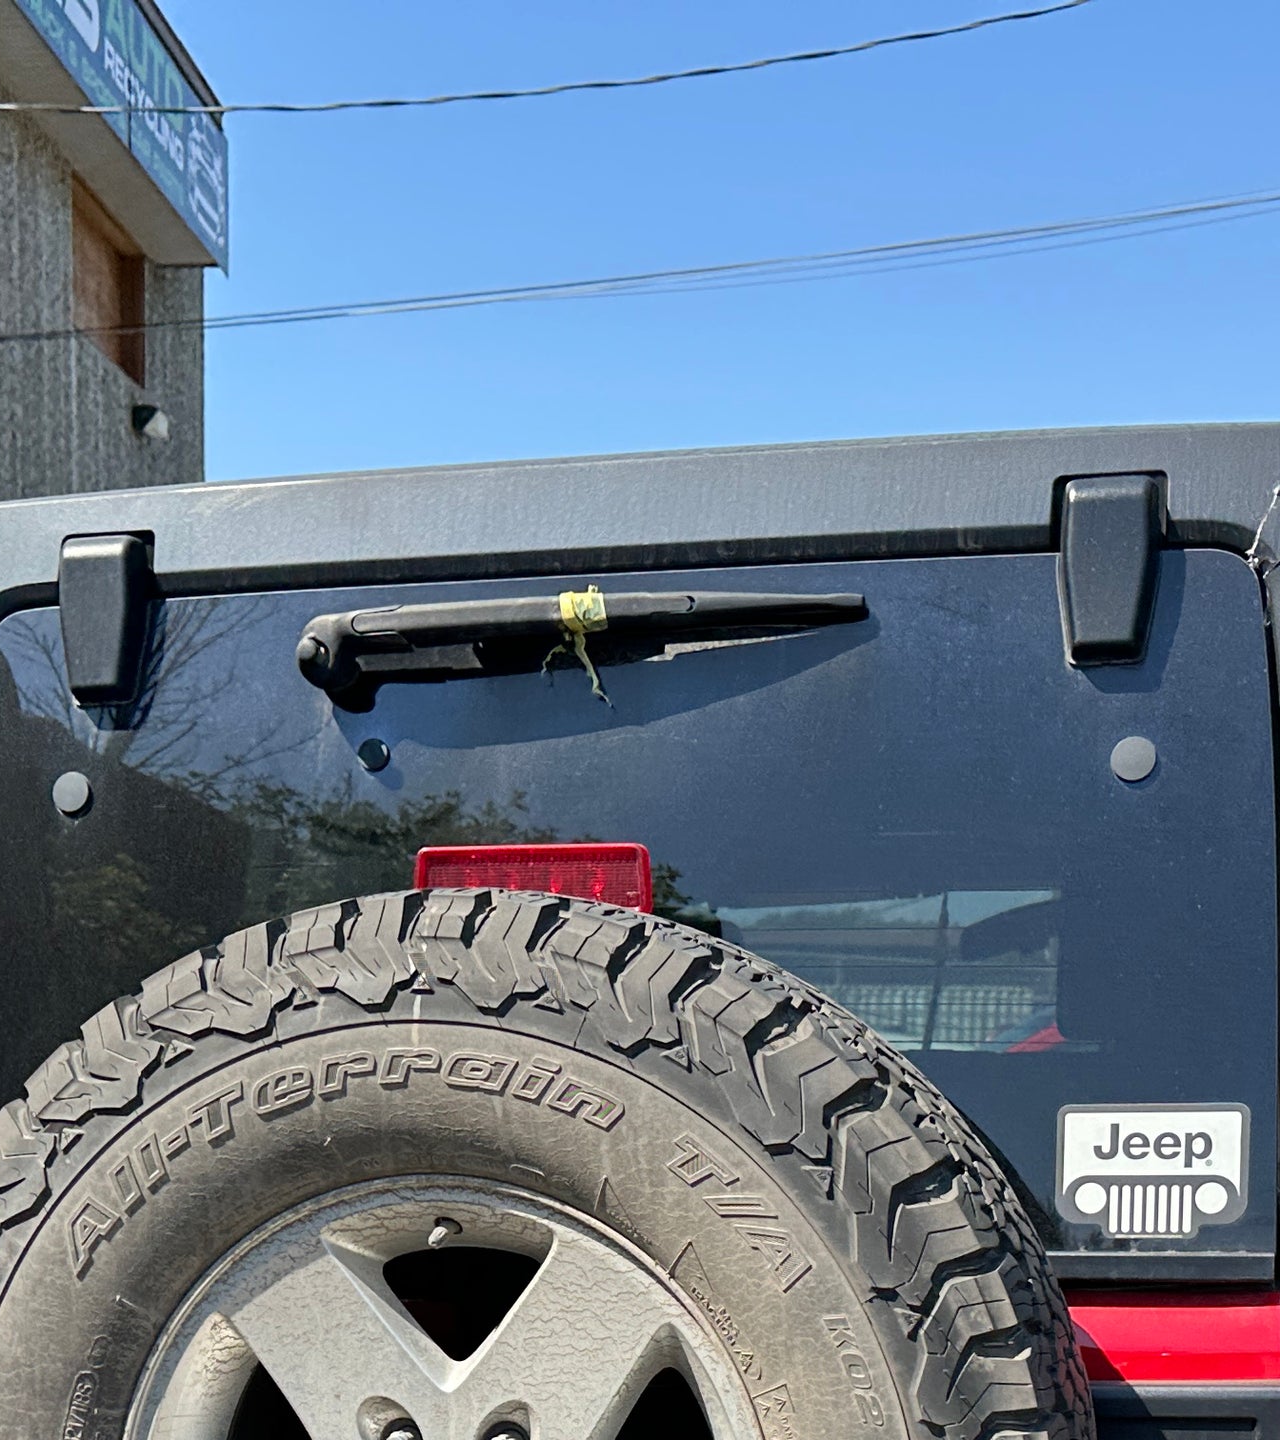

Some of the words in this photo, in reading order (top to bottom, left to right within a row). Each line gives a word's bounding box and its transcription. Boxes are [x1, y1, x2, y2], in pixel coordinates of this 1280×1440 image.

[66, 1047, 626, 1281] All-Terrain
[665, 1130, 813, 1295] T/A
[1093, 1123, 1213, 1168] Jeep
